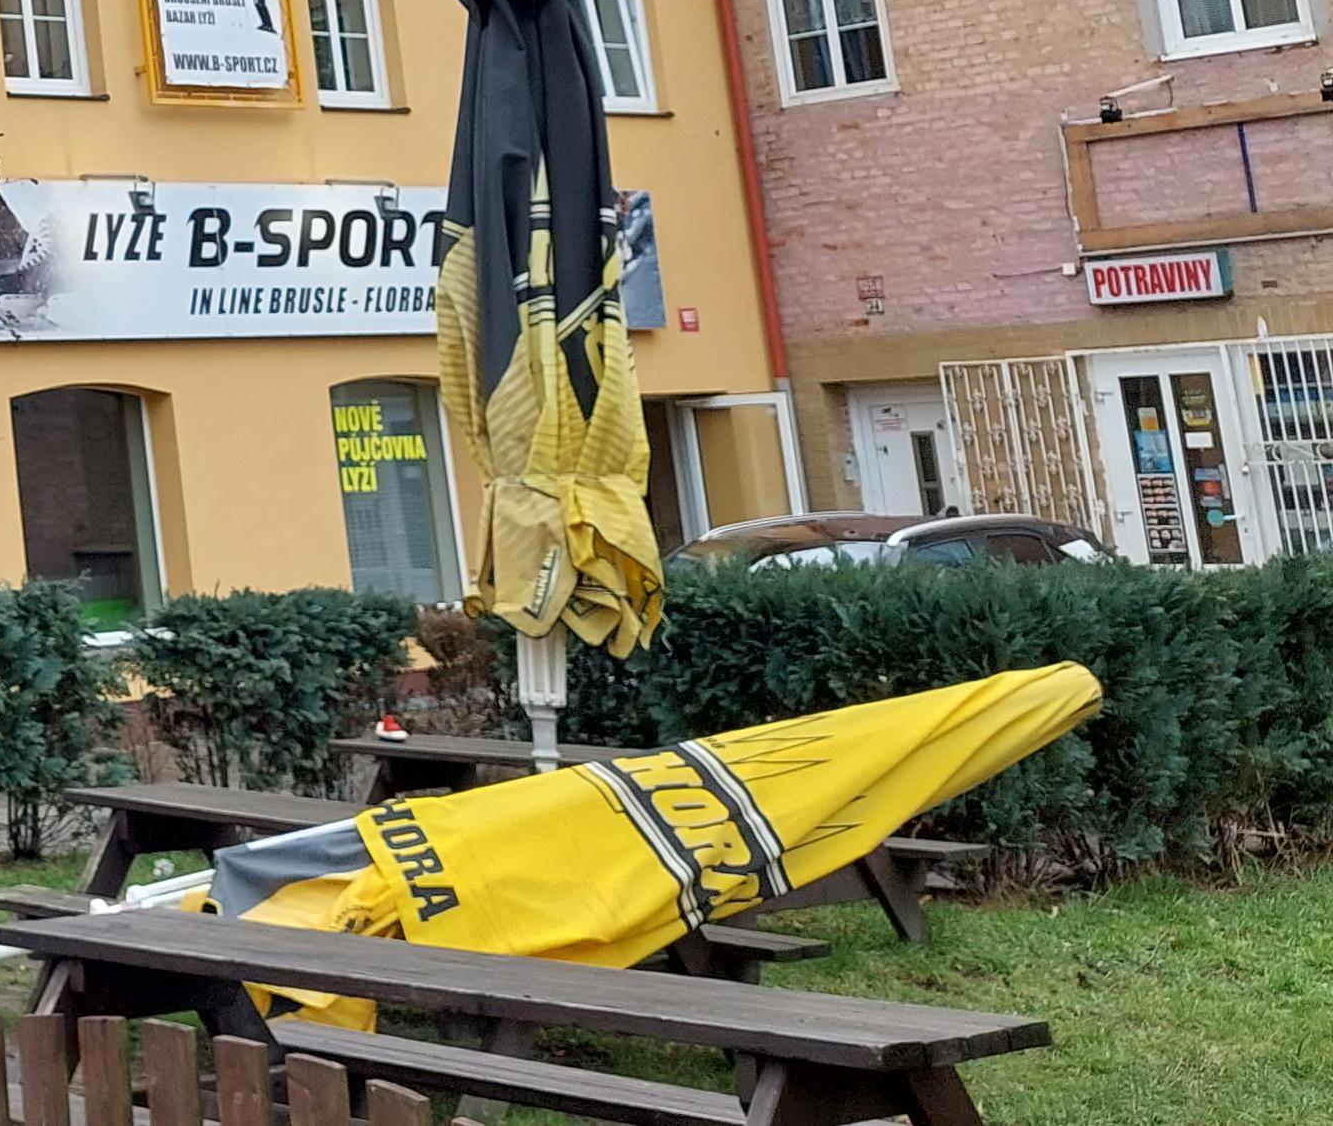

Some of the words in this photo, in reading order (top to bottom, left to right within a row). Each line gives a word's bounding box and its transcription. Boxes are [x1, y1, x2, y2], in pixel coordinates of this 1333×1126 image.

[166, 10, 196, 24] BAZAR
[173, 53, 279, 73] WWW.B-SPORT.CZ
[187, 208, 446, 267] B-SPORT
[1092, 259, 1212, 299] POTRAVINY
[190, 287, 213, 315] IN
[220, 287, 264, 315] LINE
[269, 286, 348, 315] BRUSLE
[364, 285, 437, 313] FLORBA
[337, 432, 427, 461] PŮJČOVNA
[341, 462, 378, 492] LYŽÍ
[611, 751, 764, 921] HORA
